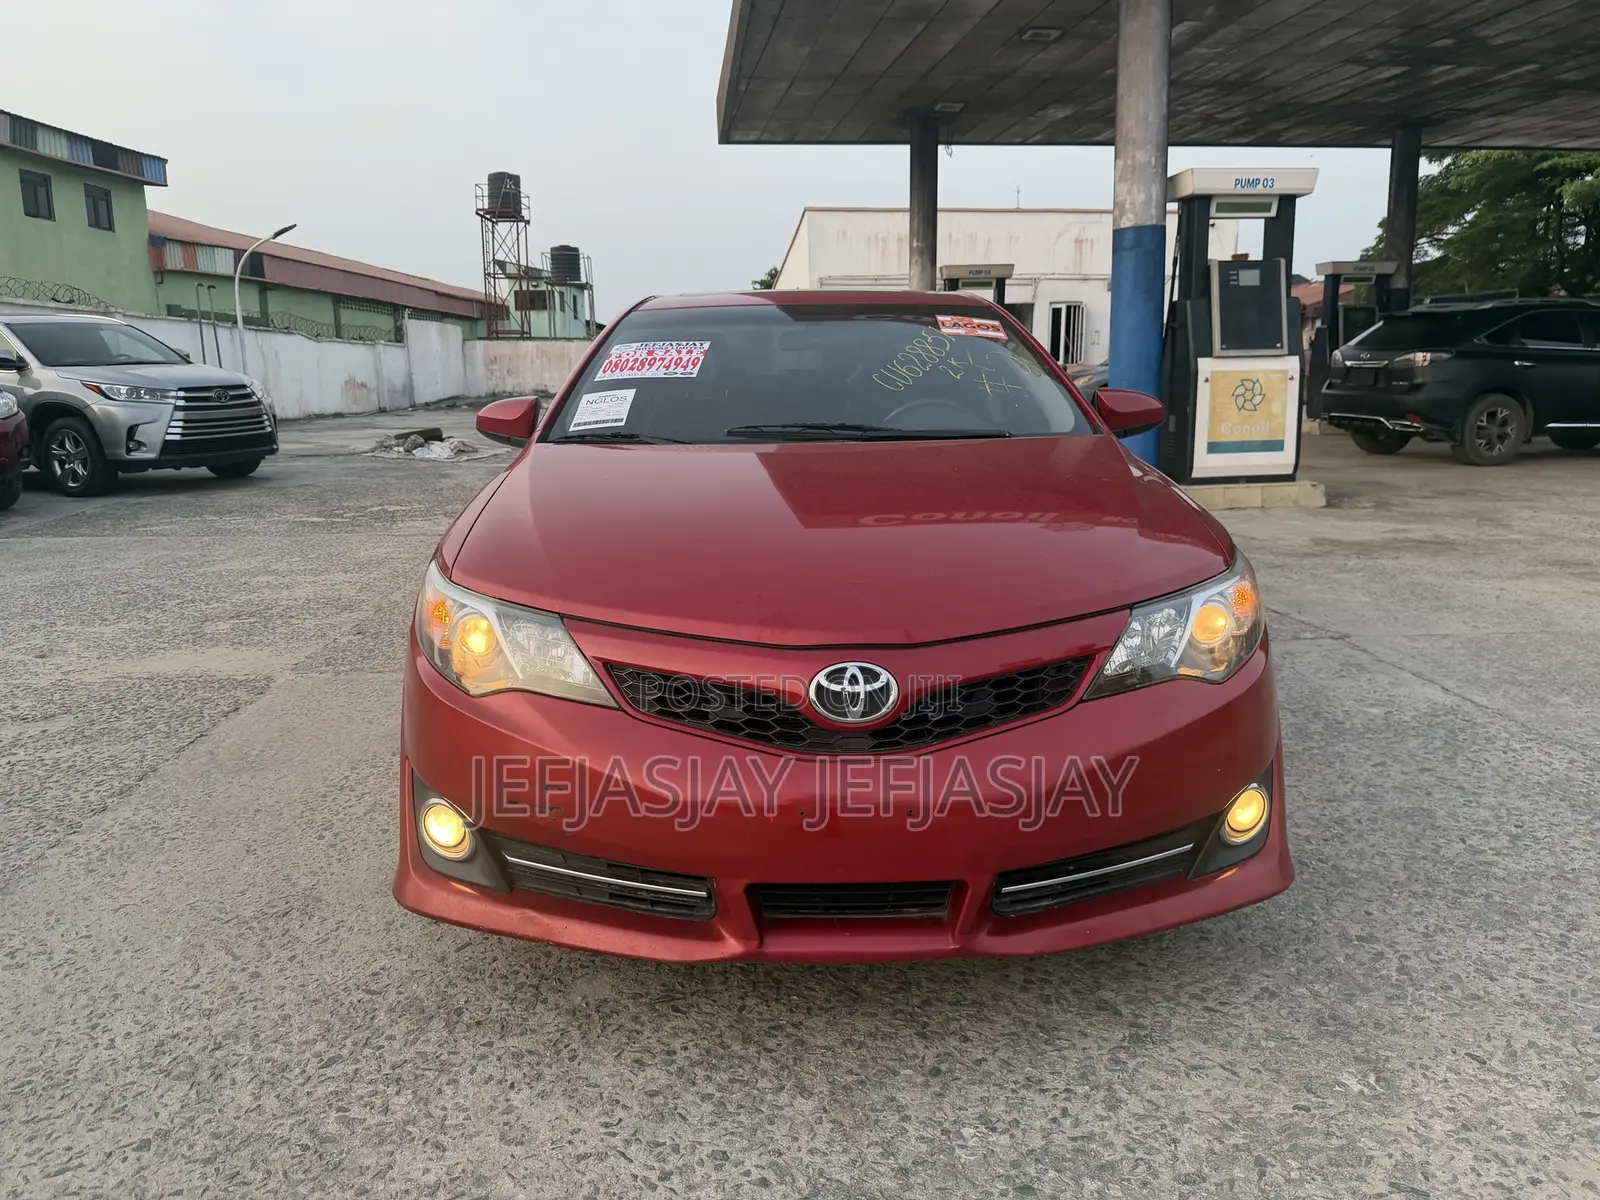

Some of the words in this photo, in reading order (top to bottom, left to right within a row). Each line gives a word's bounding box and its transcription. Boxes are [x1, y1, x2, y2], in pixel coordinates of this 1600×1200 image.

[1234, 177, 1260, 189] PUMP
[1262, 177, 1275, 189] 03
[941, 321, 1001, 332] LAGOS
[602, 356, 701, 374] 08028974949
